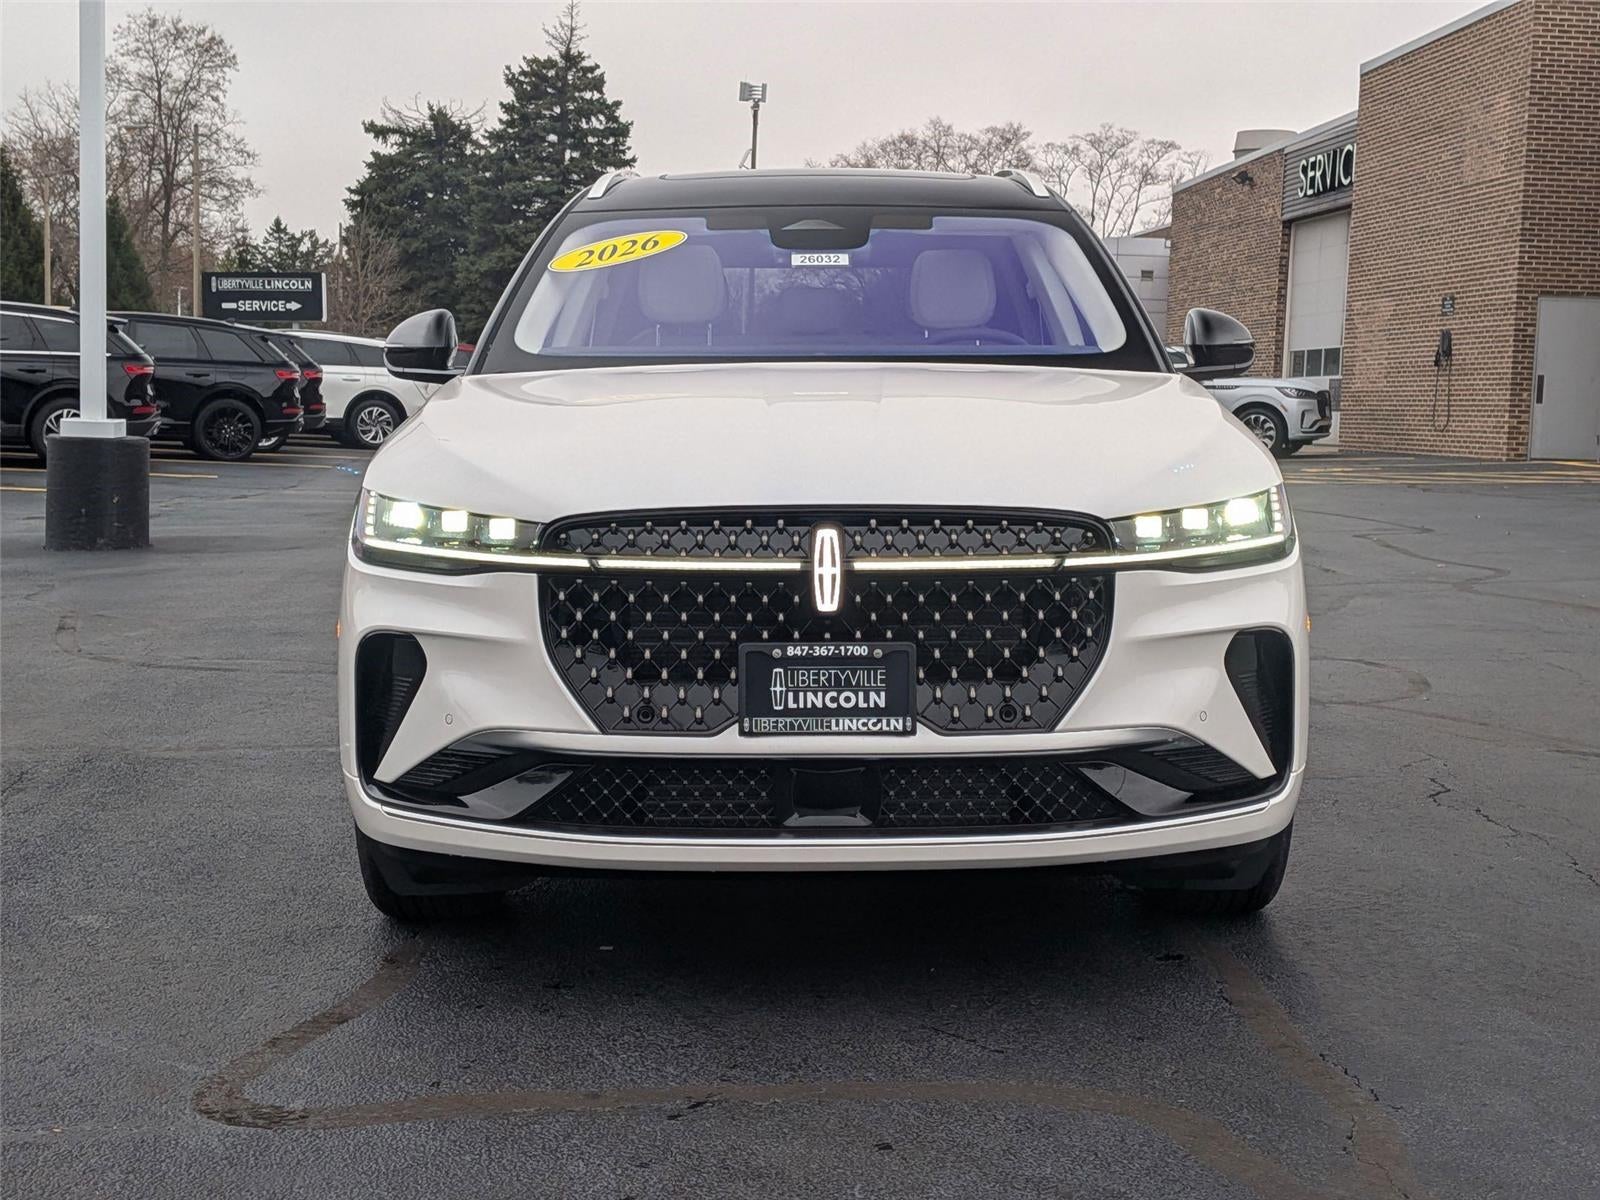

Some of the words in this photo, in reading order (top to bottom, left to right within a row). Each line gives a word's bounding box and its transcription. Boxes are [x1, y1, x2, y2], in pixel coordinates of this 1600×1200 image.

[575, 234, 660, 268] 2026
[799, 254, 841, 264] 26032
[218, 279, 263, 290] LIBERTYVILLE
[264, 279, 312, 290] LINCOLN
[238, 300, 286, 312] SERVICE
[786, 645, 868, 657] 847-367-1700
[787, 669, 886, 687] LIBERTYVILLE
[787, 690, 886, 709] LINCOLN
